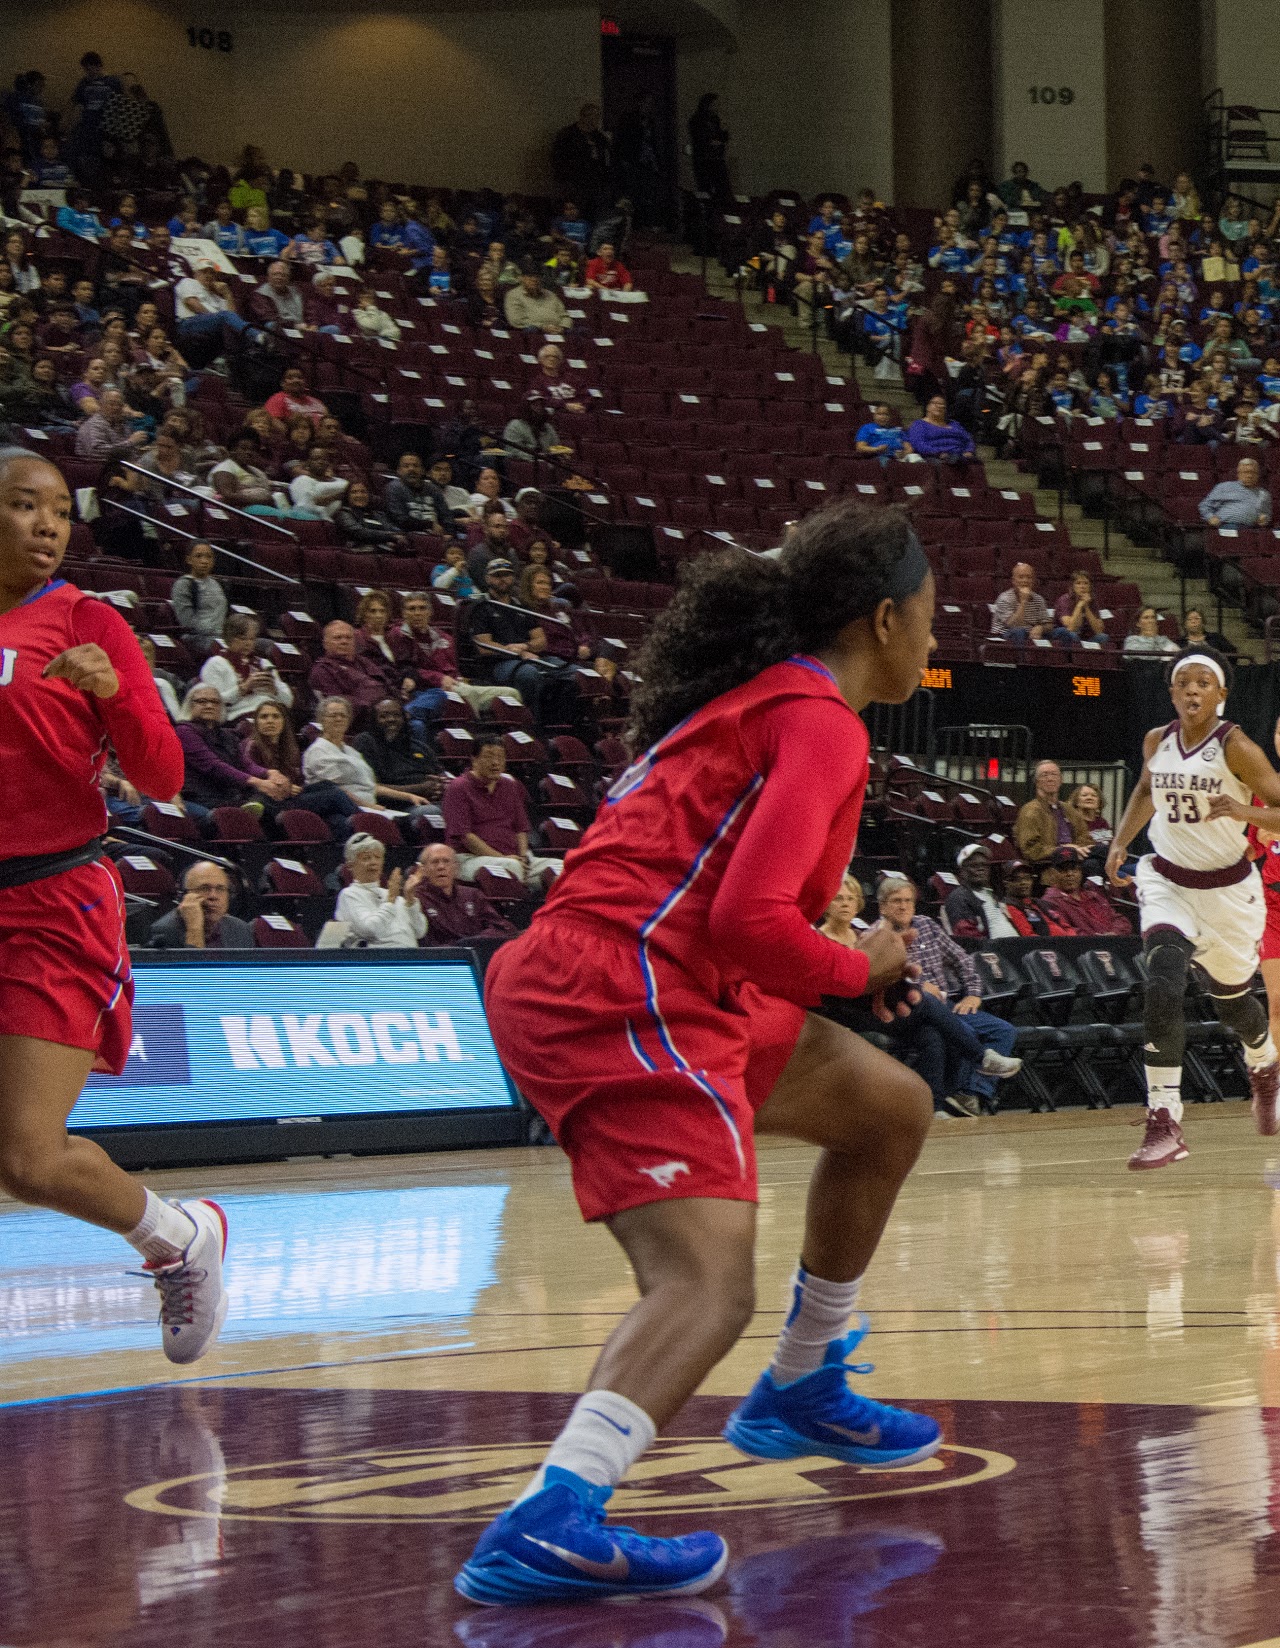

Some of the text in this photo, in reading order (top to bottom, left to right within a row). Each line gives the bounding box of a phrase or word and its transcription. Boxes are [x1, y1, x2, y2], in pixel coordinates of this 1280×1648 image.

[187, 27, 233, 52] 108
[1029, 86, 1074, 105] 109
[1189, 774, 1222, 794] A&M
[1166, 792, 1201, 823] 33
[282, 1012, 463, 1068] KOCH
